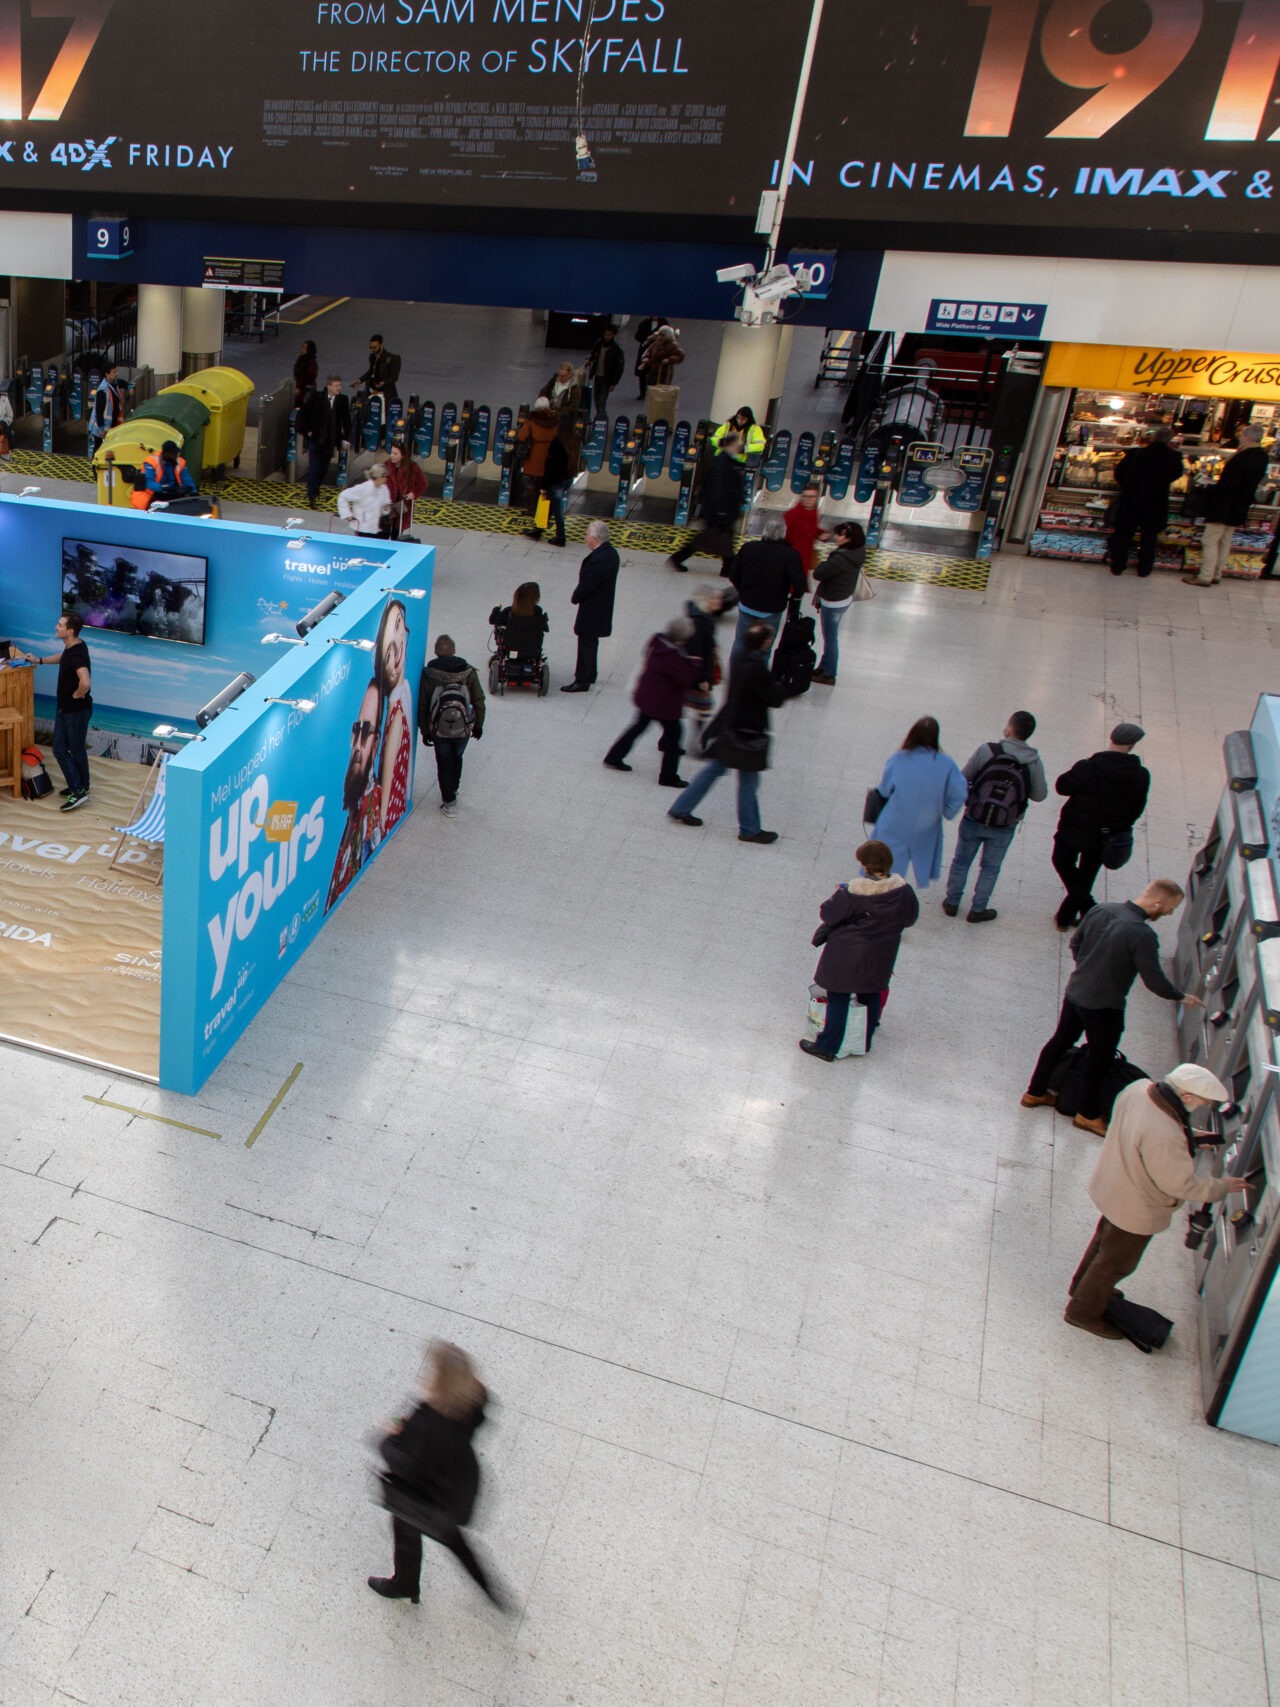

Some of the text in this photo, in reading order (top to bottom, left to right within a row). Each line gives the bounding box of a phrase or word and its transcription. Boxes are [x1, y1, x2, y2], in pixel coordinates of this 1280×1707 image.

[317, 0, 666, 25] FROM SAM MENDES
[299, 38, 689, 74] THE DIRECTOR OF SKYFALL
[963, 0, 1280, 141] 191
[23, 141, 39, 163] &
[50, 136, 118, 171] 4DX
[128, 143, 235, 169] FRIDAY
[770, 160, 1275, 199] IN CINEMAS, IMAX &
[96, 225, 130, 249] 9 9
[1133, 351, 1228, 388] Upper
[284, 557, 348, 576] travel up
[211, 775, 232, 813] Mel
[233, 743, 267, 790] upped
[268, 725, 286, 755] her
[321, 660, 351, 700] holiday
[209, 773, 269, 882] up
[97, 839, 149, 864] up
[76, 874, 164, 904] Holidays
[207, 794, 326, 1001] yours
[113, 952, 161, 971] SIM
[204, 986, 237, 1041] travel
[237, 966, 248, 989] up
